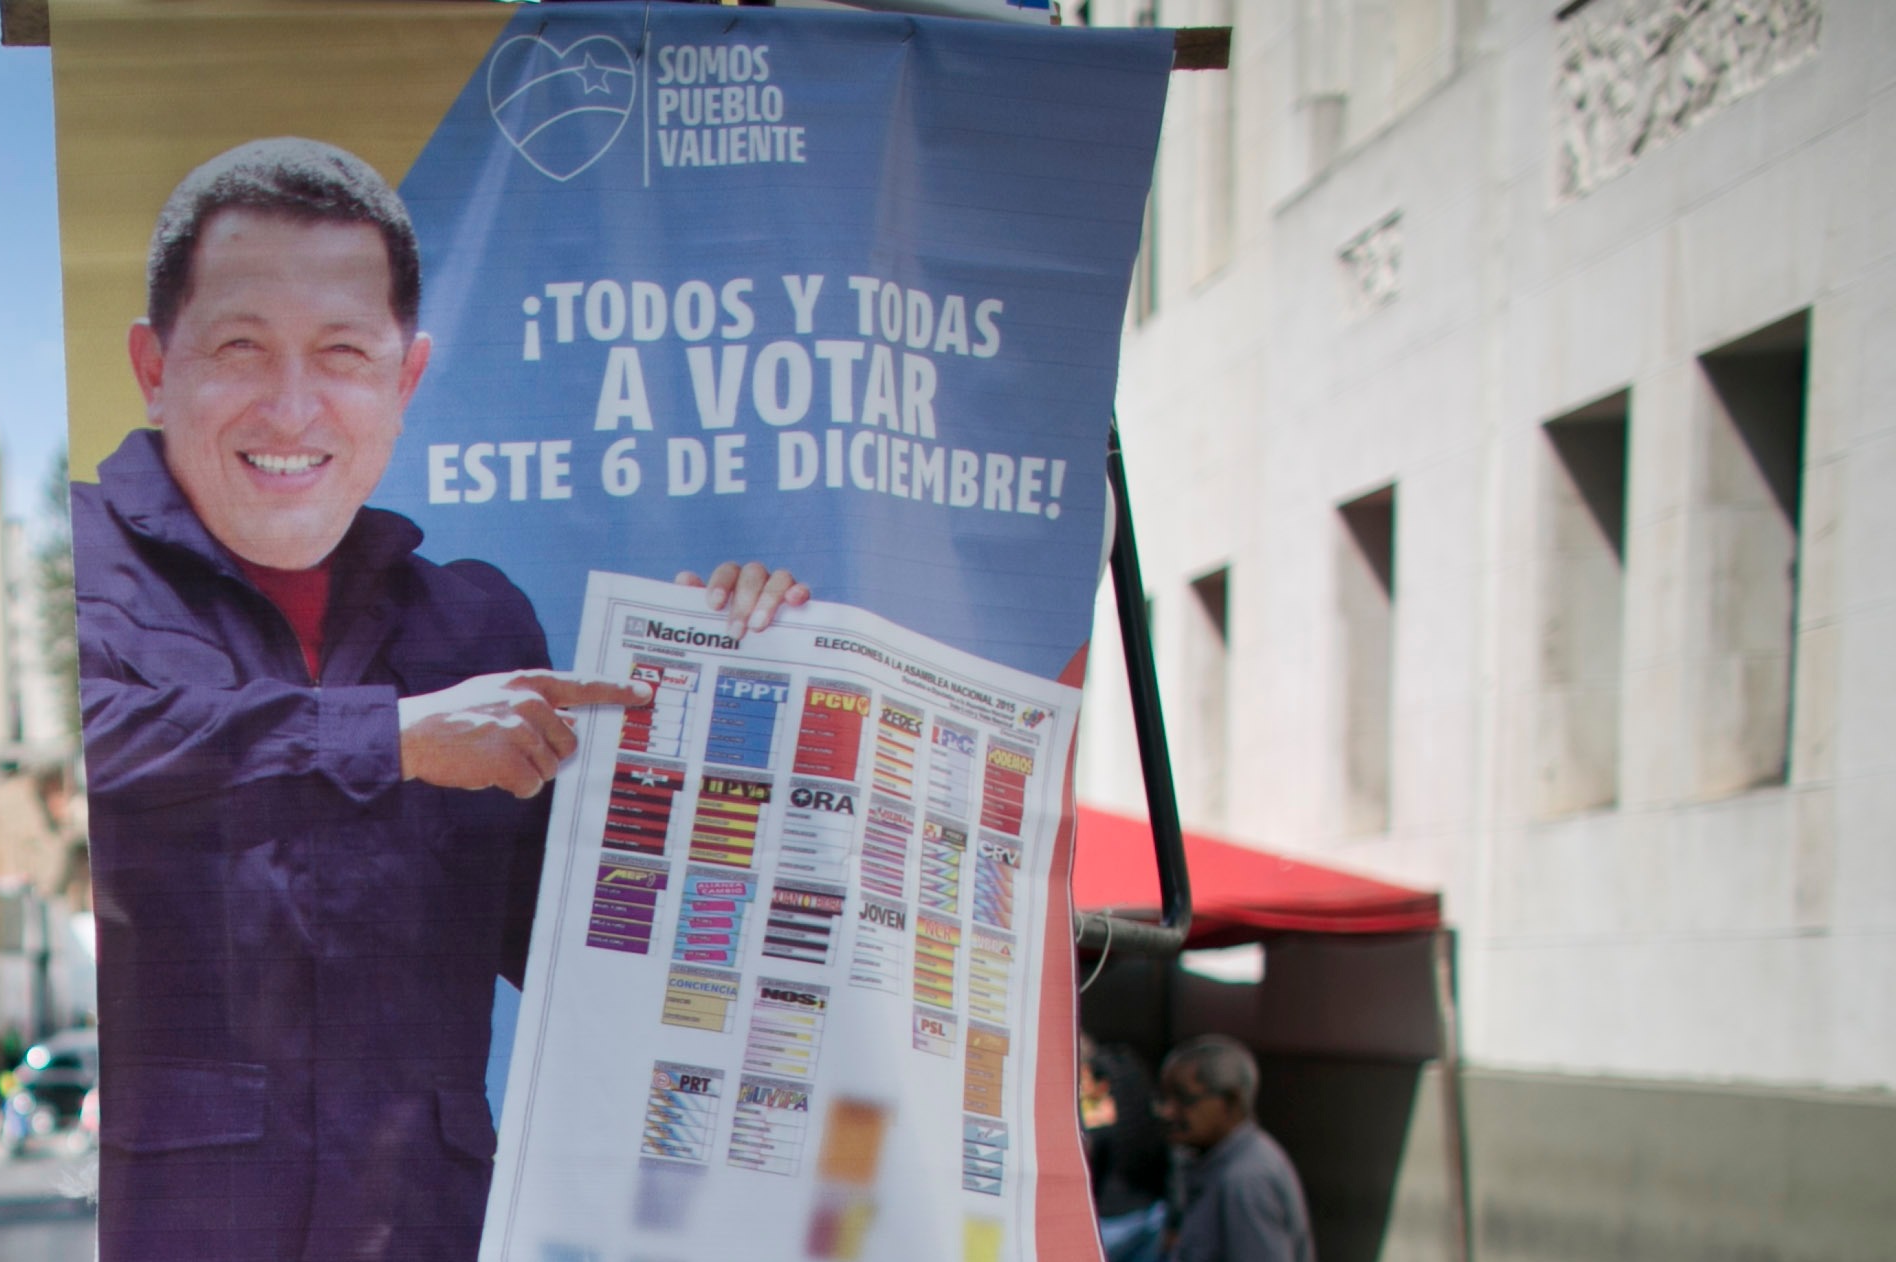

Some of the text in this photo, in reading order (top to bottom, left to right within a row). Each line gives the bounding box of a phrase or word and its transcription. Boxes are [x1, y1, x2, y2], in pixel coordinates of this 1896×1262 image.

[658, 45, 770, 84] SOMOS
[658, 85, 784, 126] PUEBLO
[658, 125, 806, 168] VALIENTE
[522, 274, 1004, 361] ¡TODOS Y TODAS
[594, 340, 938, 440] A VOTAR
[428, 431, 1067, 520] ESTE 6 DE DICIEMBRE!
[815, 636, 883, 663] ELECCIONES
[883, 655, 891, 667] A
[891, 657, 902, 672] LA
[904, 661, 949, 689] ASAMBLEA
[951, 681, 993, 707] NACIONAL
[995, 697, 1016, 713] 2015
[810, 691, 858, 711] PCV
[881, 706, 924, 738] REDES
[987, 748, 1033, 776] PODEMOS
[790, 786, 855, 815] ORA
[859, 902, 906, 931] JOVEN
[668, 978, 738, 996] CONCIENCIA
[921, 1018, 946, 1037] PSL
[679, 1075, 711, 1092] PRT
